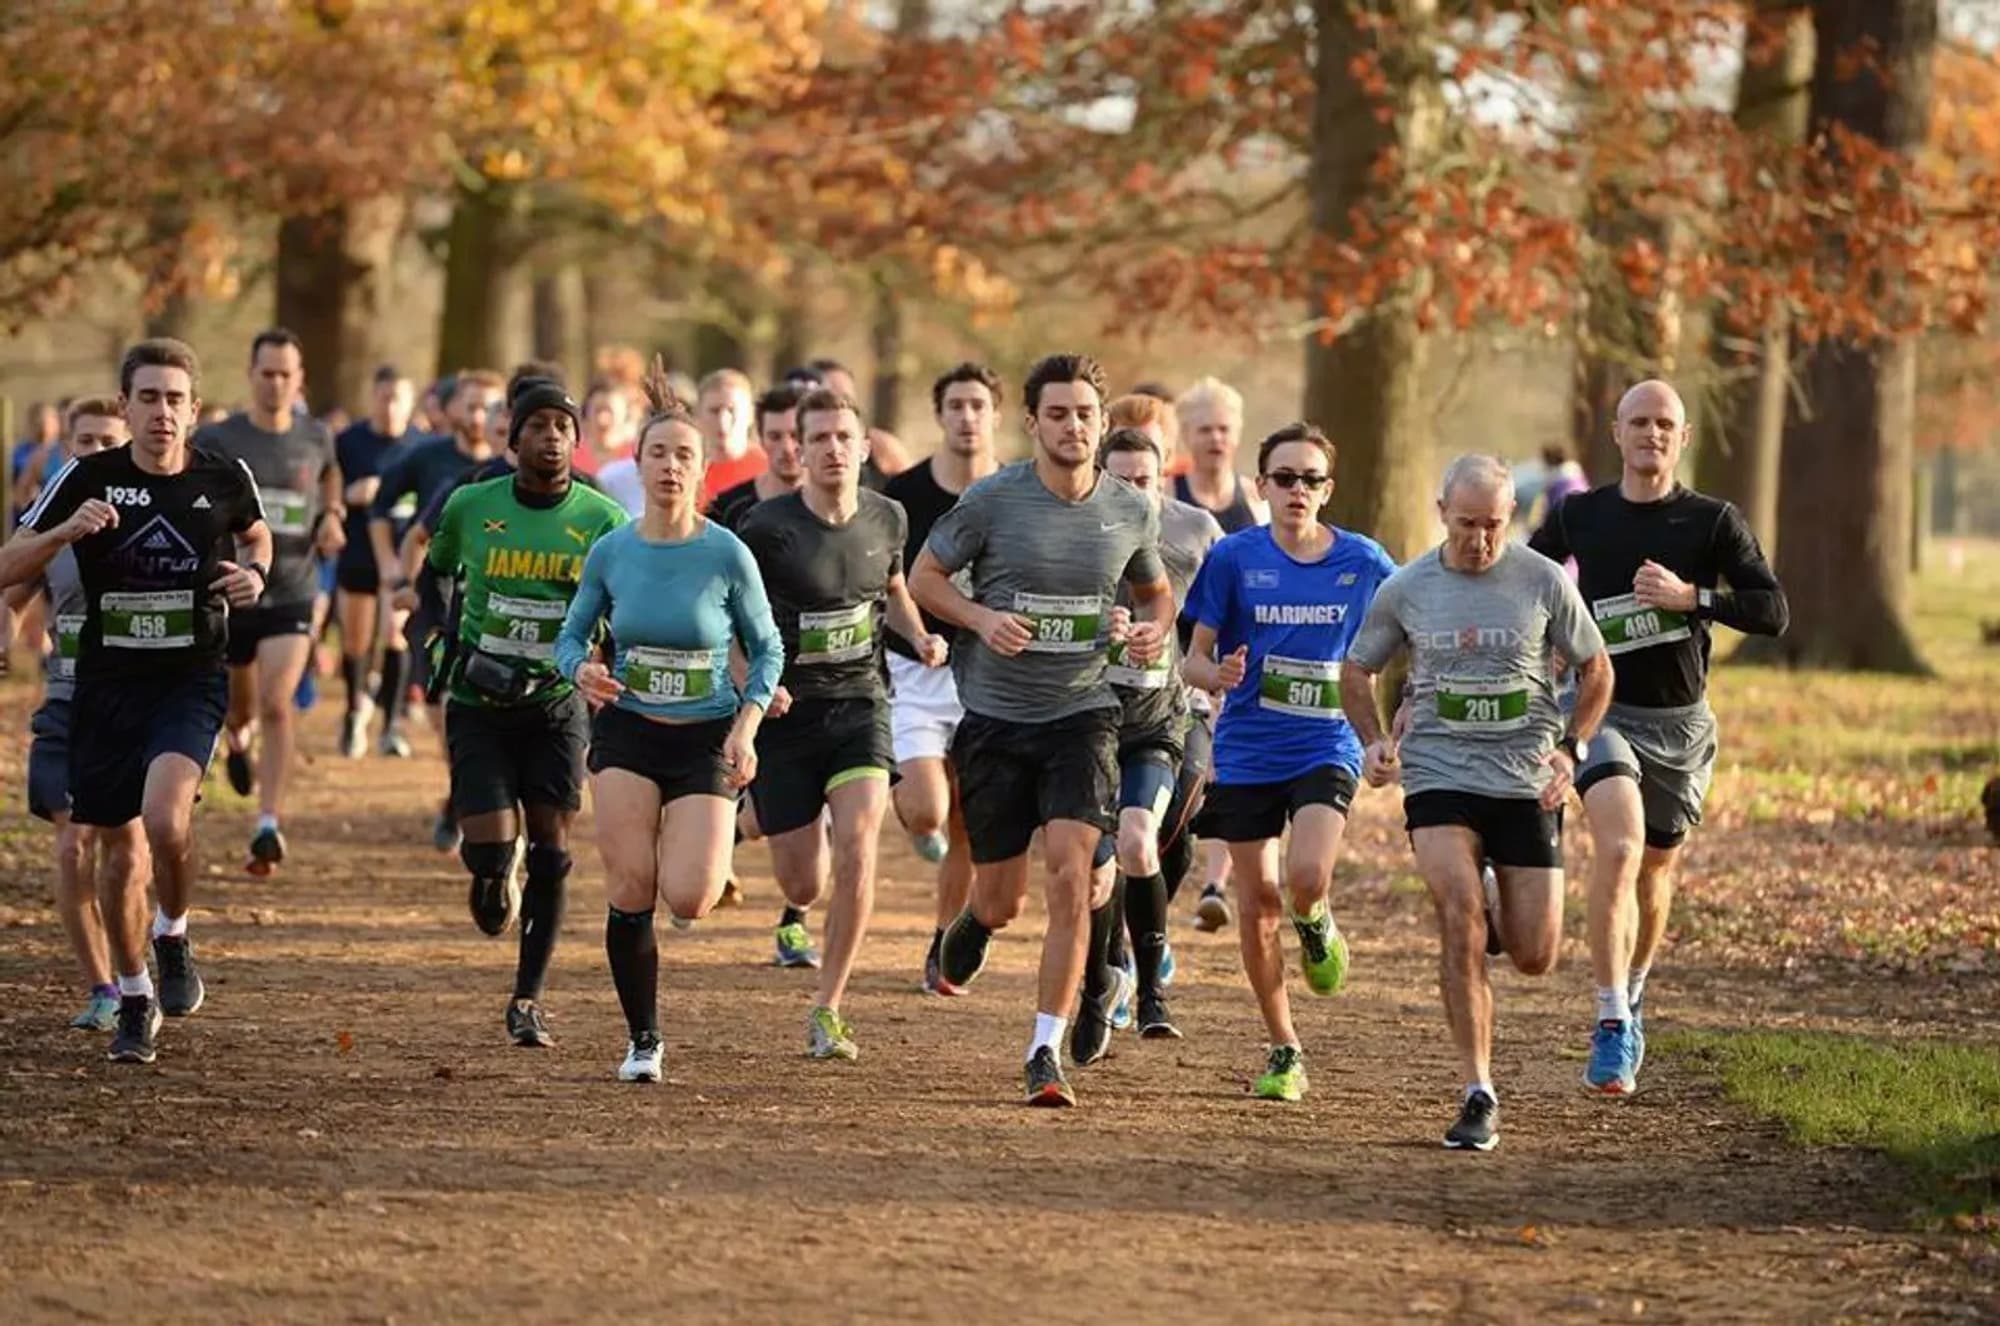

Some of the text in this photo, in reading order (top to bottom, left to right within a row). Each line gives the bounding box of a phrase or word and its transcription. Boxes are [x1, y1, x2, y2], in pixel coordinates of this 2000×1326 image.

[105, 486, 152, 506] 1936
[485, 547, 582, 582] JAMAICA
[129, 615, 167, 638] 458
[1253, 603, 1349, 625] HARINGEY
[1625, 611, 1660, 640] 480
[508, 618, 540, 642] 215
[827, 628, 855, 653] 547
[1039, 617, 1075, 642] 528
[648, 669, 686, 696] 509
[1288, 681, 1323, 707] 501
[1465, 698, 1500, 721] 201
